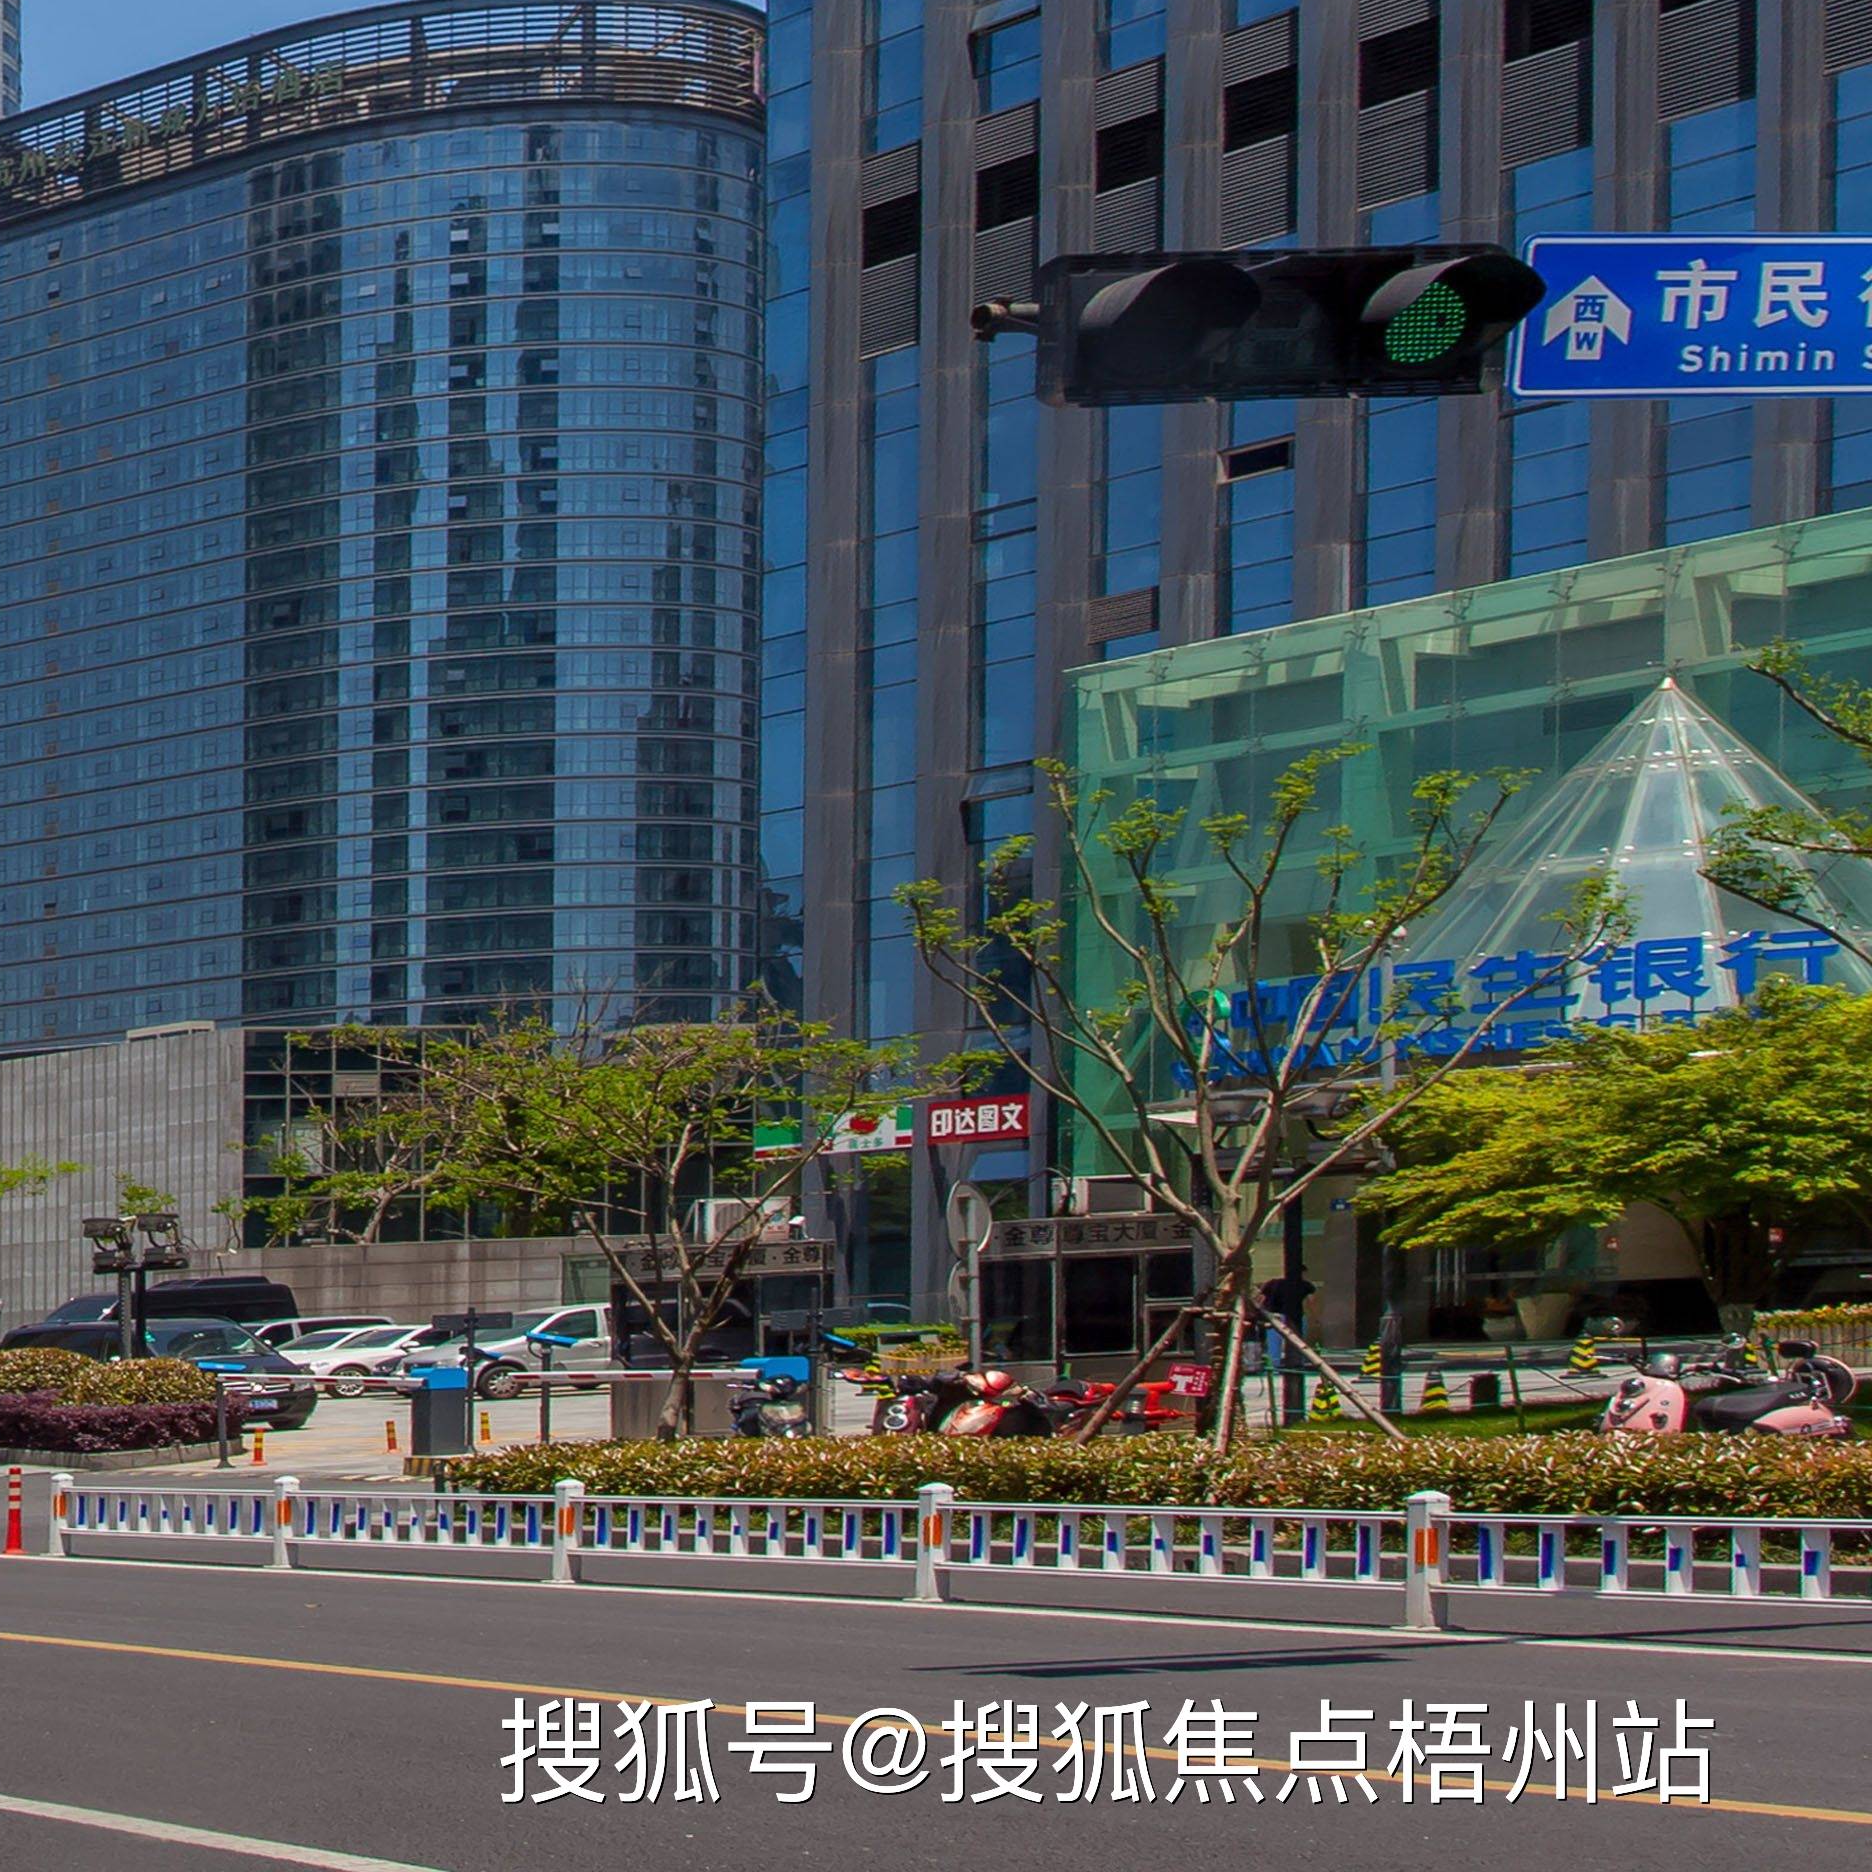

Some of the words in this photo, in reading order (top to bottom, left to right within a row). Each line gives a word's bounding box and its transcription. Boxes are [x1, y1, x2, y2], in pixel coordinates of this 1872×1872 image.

[1574, 294, 1608, 323] 西
[1657, 259, 1872, 329] 市民
[1576, 331, 1599, 351] W
[1679, 342, 1836, 373] Shimin
[1231, 929, 1839, 1031] 中国民生银行
[931, 1103, 1023, 1136] 印达图文
